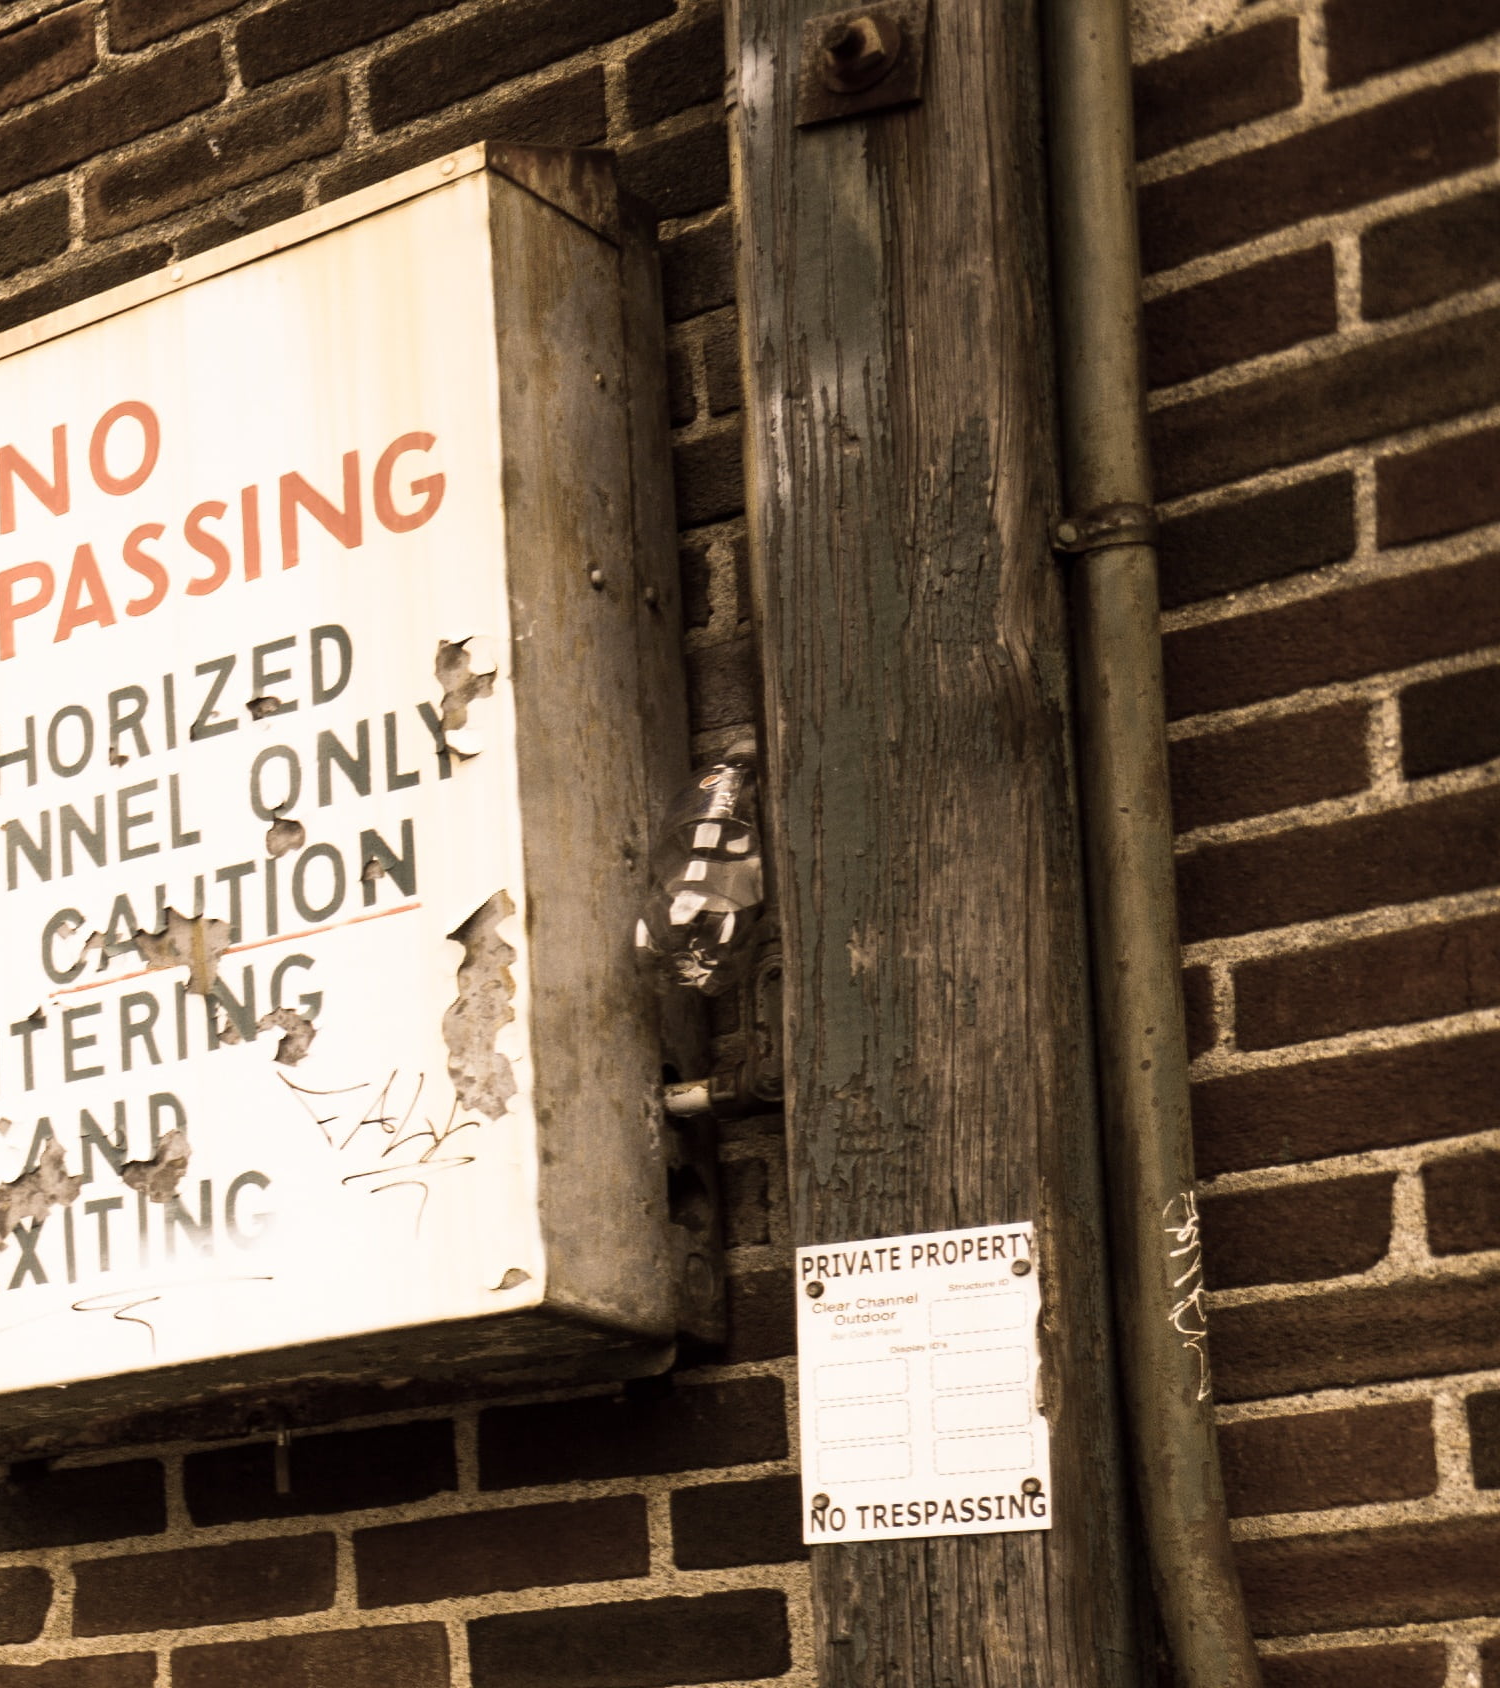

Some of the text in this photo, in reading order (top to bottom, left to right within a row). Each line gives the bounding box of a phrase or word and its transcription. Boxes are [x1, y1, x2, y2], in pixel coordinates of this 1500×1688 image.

[249, 701, 466, 822] ONLY
[801, 1232, 1034, 1281] PRIVATE PROPERTY
[948, 1278, 1010, 1292] Structure ID
[811, 1293, 919, 1315] Clear Channel
[834, 1311, 898, 1326] Outdoor
[890, 1342, 926, 1354] Display
[810, 1492, 1047, 1533] NO TRESPASSING
